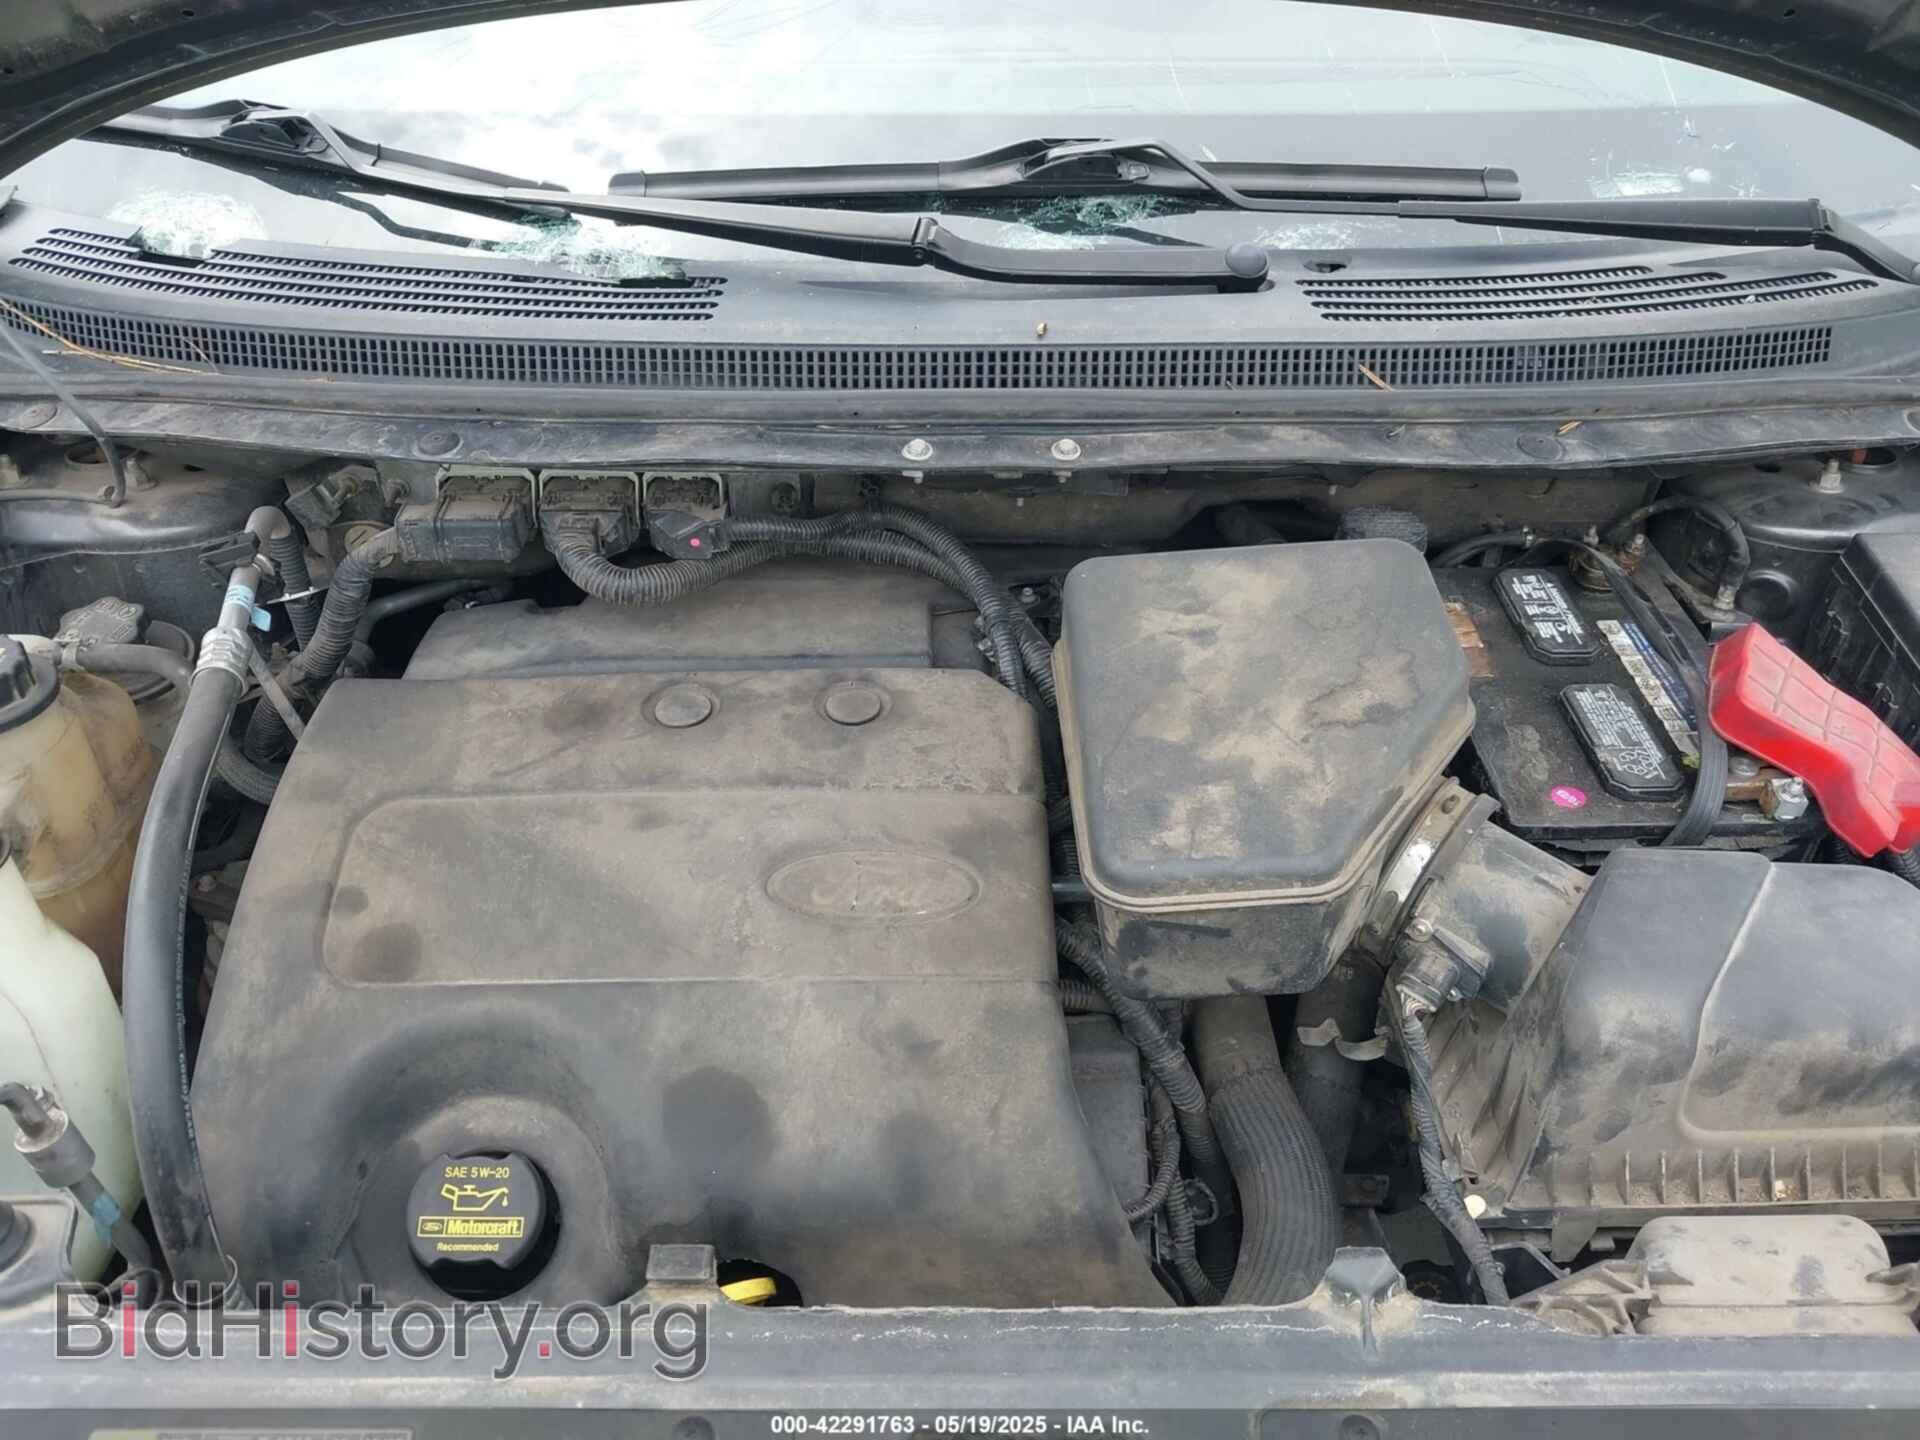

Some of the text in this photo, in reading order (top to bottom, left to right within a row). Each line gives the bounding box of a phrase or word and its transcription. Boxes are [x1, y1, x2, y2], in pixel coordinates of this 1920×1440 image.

[444, 1166, 510, 1178] SAE 5W-20
[446, 1218, 518, 1235] Motorcraft
[436, 1242, 500, 1252] Recommended
